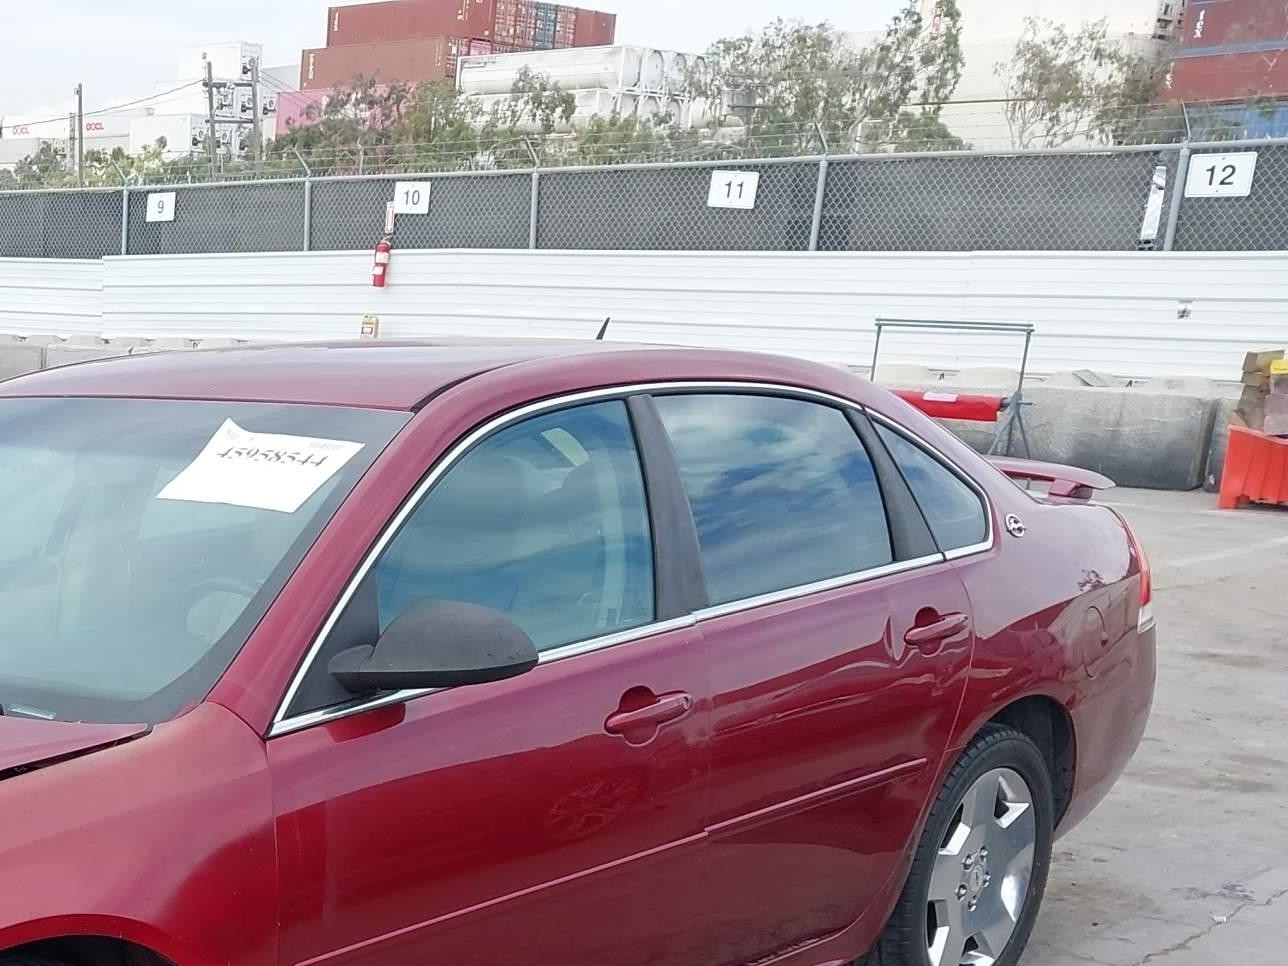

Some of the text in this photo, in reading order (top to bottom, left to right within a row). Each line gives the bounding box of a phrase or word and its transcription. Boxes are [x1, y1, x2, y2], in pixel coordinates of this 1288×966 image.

[86, 123, 104, 132] OOCL
[1206, 164, 1236, 186] 12
[403, 189, 421, 206] 10
[725, 180, 744, 199] 11
[157, 199, 165, 214] 9
